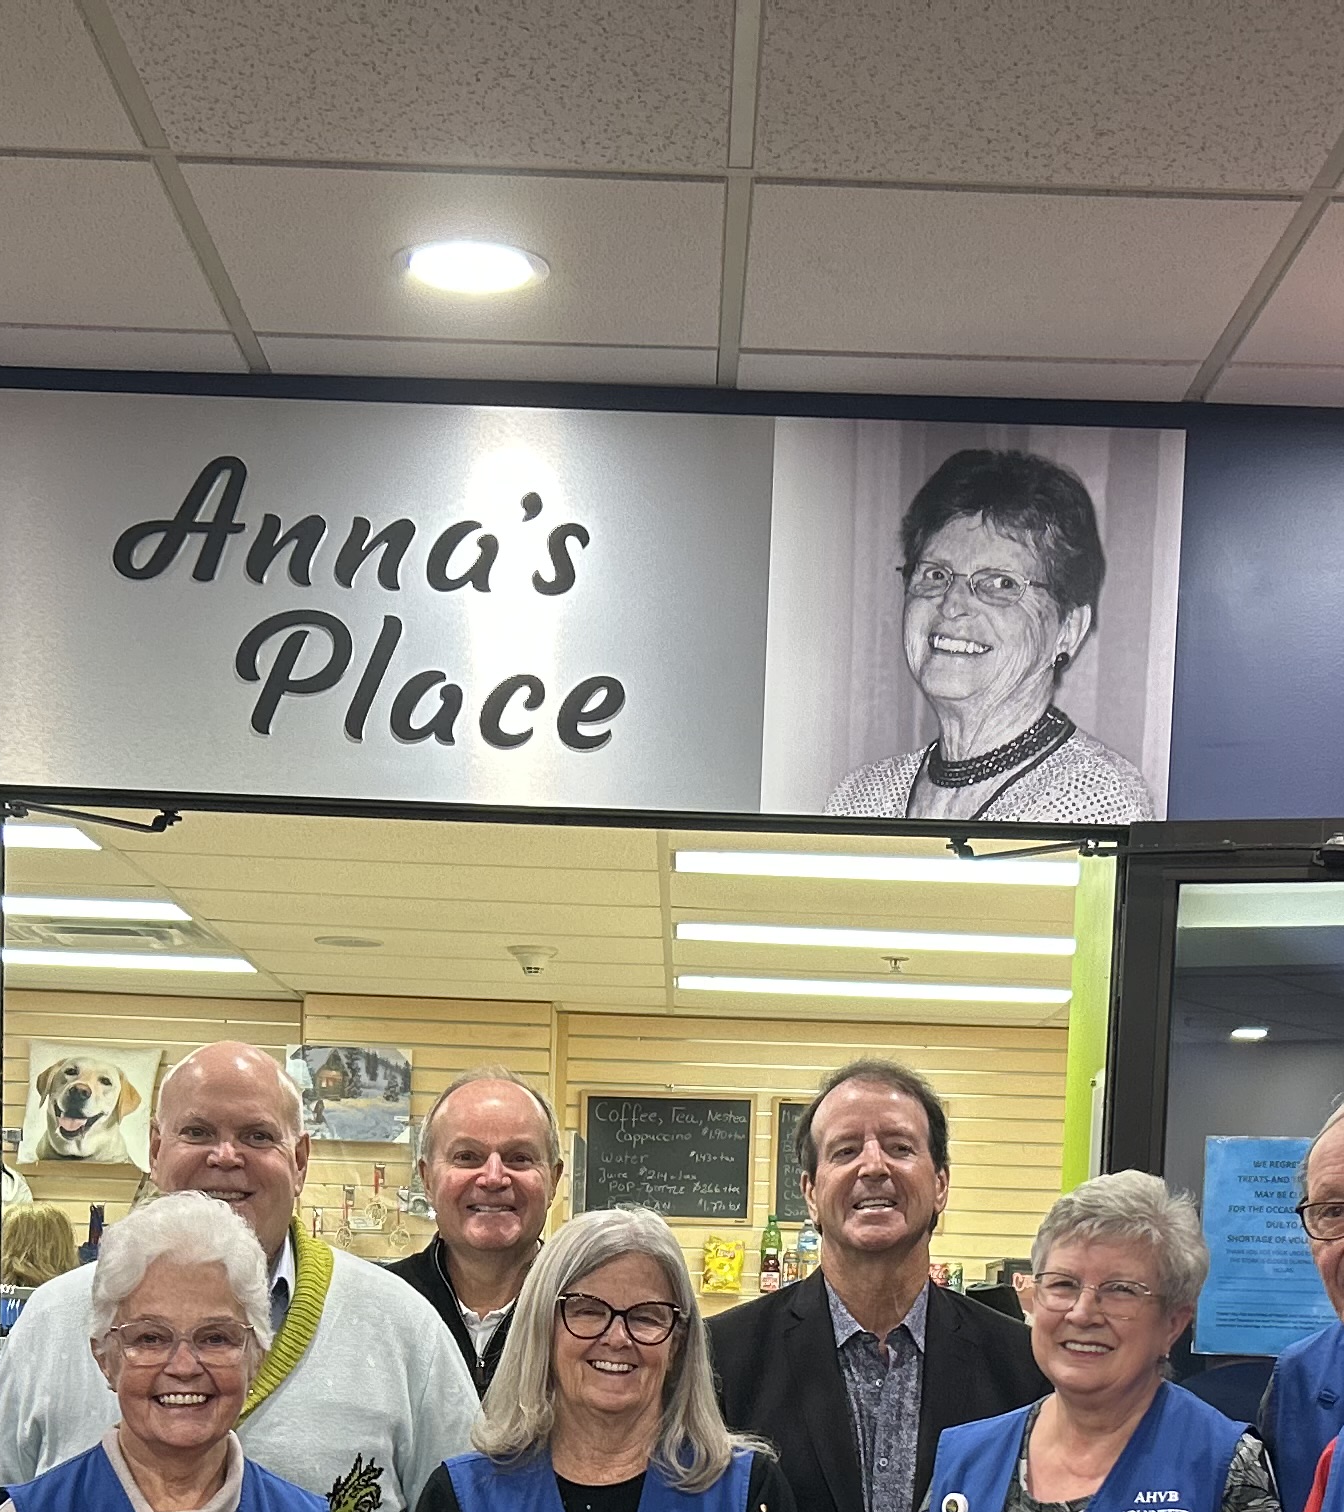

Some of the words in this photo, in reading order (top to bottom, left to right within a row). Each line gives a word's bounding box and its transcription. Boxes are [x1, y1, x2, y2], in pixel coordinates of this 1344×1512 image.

[113, 455, 590, 596] Anna's
[235, 608, 626, 751] Place
[594, 1101, 664, 1131] Coffee,
[671, 1106, 703, 1126] Tea,
[707, 1109, 748, 1124] Nestea
[615, 1130, 693, 1149] Cappuccino
[601, 1151, 650, 1164] Water
[1253, 1160, 1267, 1168] WE
[1254, 1190, 1274, 1198] MAY
[1277, 1191, 1287, 1199] BE
[1228, 1205, 1246, 1213] FOR
[1248, 1205, 1264, 1213] THE
[1266, 1221, 1285, 1229] DUE
[1286, 1221, 1298, 1229] TO
[1227, 1235, 1273, 1243] SHORTAGE
[1275, 1236, 1287, 1244] OF
[1134, 1490, 1180, 1504] AHVB
